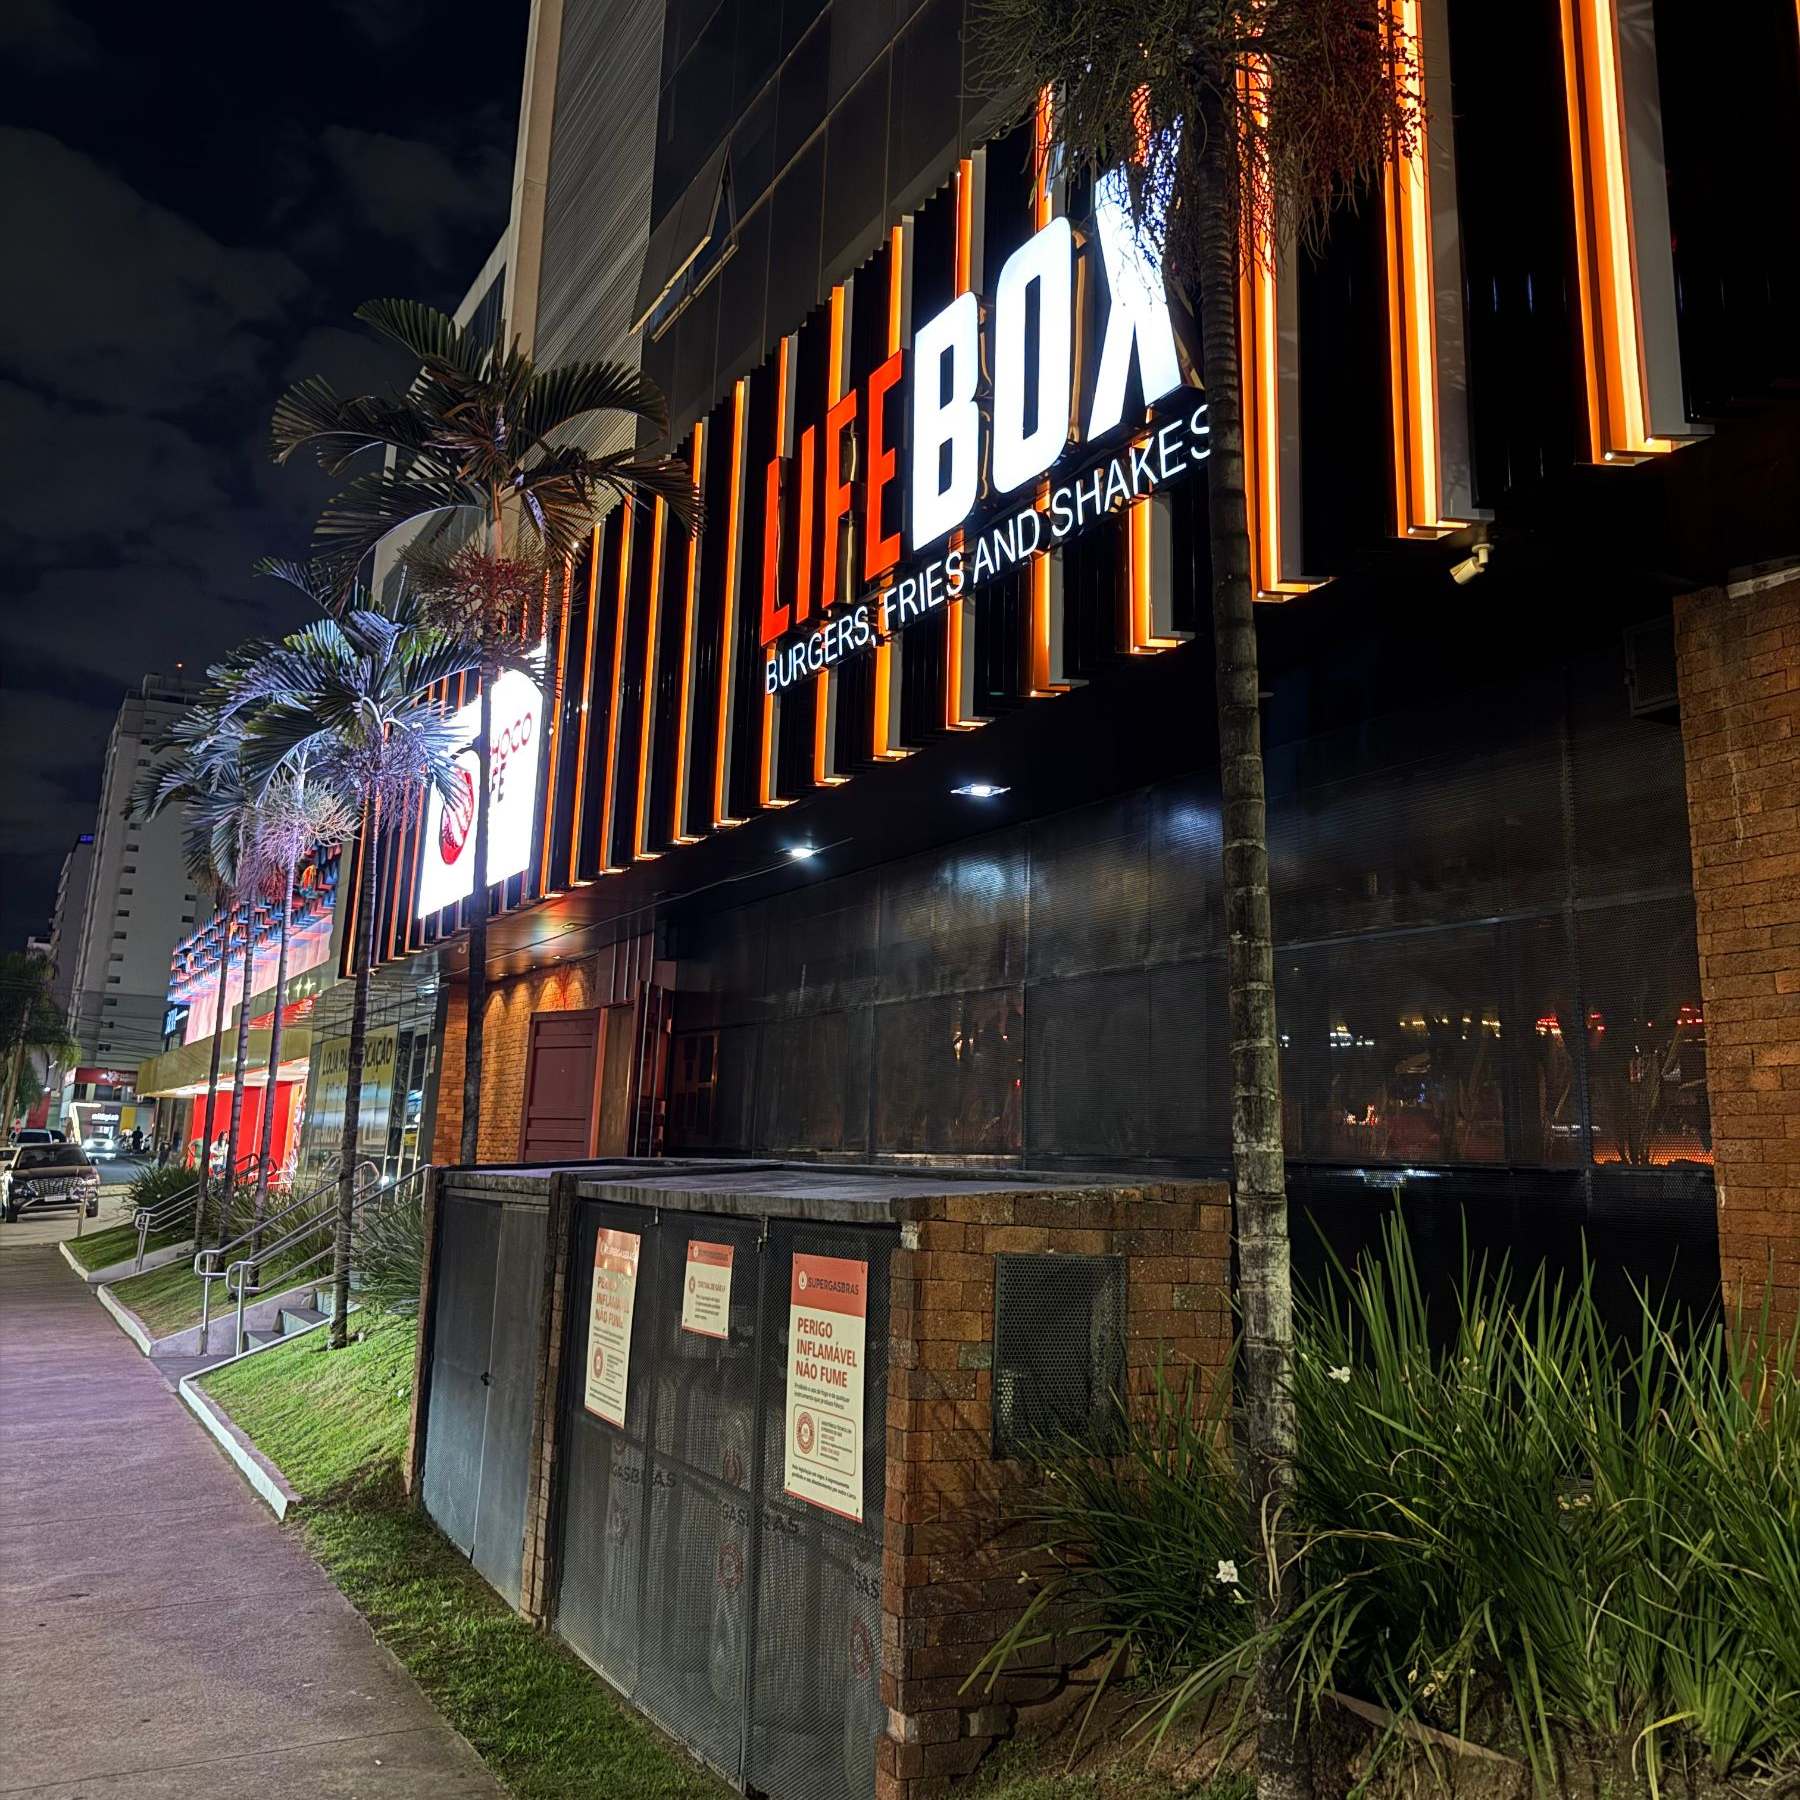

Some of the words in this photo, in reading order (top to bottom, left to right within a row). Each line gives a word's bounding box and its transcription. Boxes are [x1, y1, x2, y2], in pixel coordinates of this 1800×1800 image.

[766, 606, 877, 694] BURGERS,
[884, 551, 964, 631] FRIES
[973, 508, 1040, 584] AND
[1051, 404, 1211, 537] SHAKES
[491, 712, 532, 764] HOCO
[322, 1050, 338, 1075] LOJA
[362, 1035, 393, 1073] OCAÇÃO
[807, 1277, 859, 1295] SUPERGASBRAS
[797, 1317, 832, 1338] PERIGO
[796, 1338, 857, 1367] INFLAMÁVEL
[795, 1358, 817, 1380] NÃO
[820, 1366, 847, 1388] FUME
